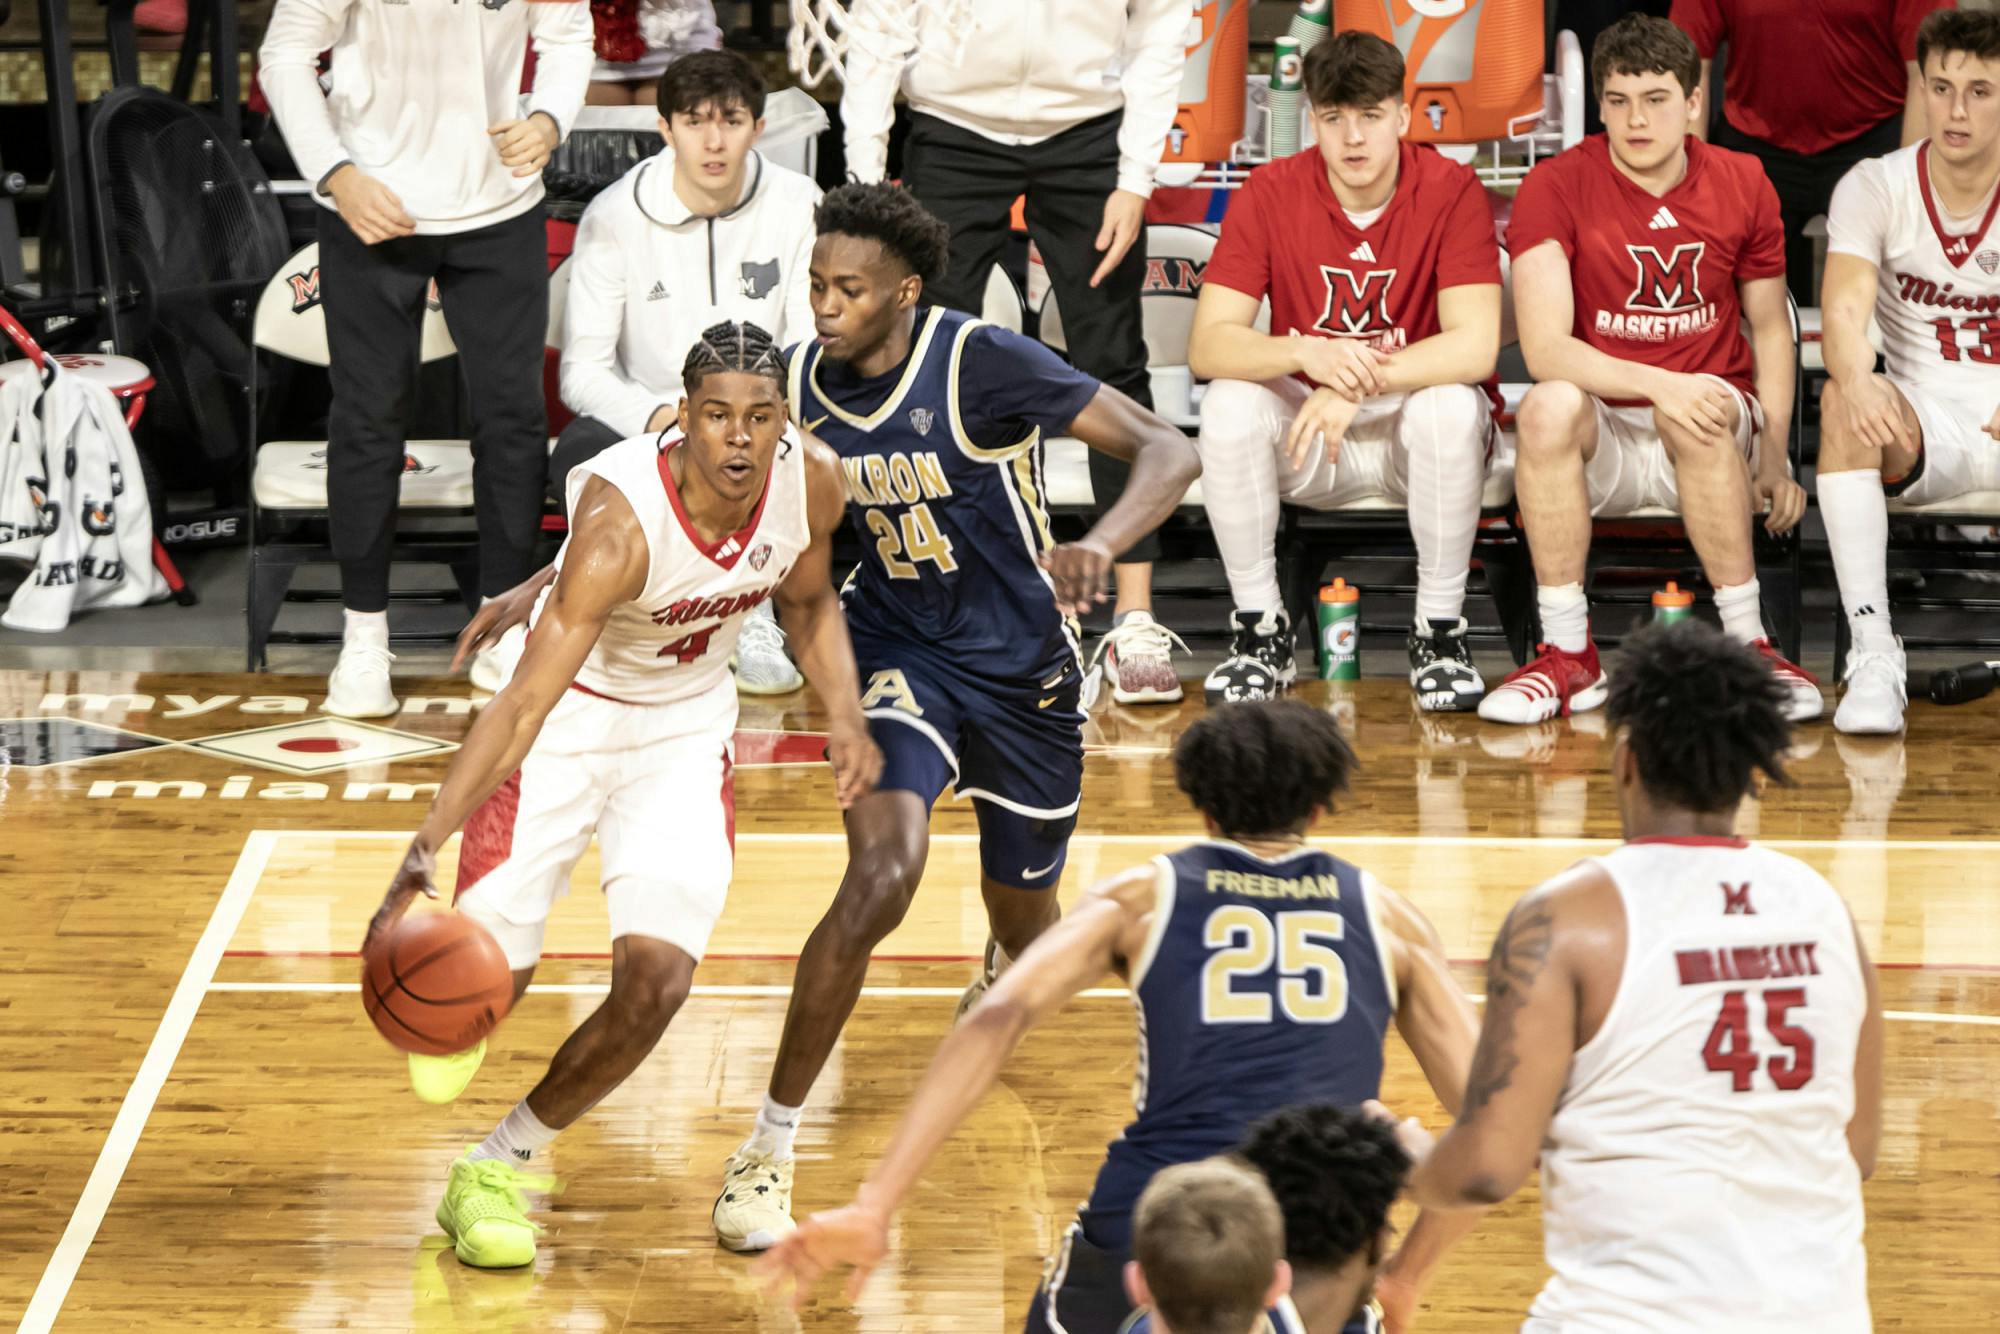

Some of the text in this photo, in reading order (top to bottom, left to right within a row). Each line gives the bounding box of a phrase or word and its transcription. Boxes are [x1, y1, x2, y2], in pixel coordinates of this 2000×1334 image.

[1313, 265, 1397, 337] M
[1625, 242, 1705, 313] M
[1595, 303, 1719, 341] BASKETBALL
[1925, 315, 2000, 364] 13
[842, 452, 953, 505] KRON
[865, 502, 959, 580] 24
[657, 623, 722, 664] 4
[1327, 620, 1356, 655] G
[858, 668, 925, 717] A
[1206, 869, 1341, 899] FREEMAN
[1719, 881, 1758, 915] M
[1201, 904, 1349, 1025] 25
[1702, 987, 1815, 1092] 45
